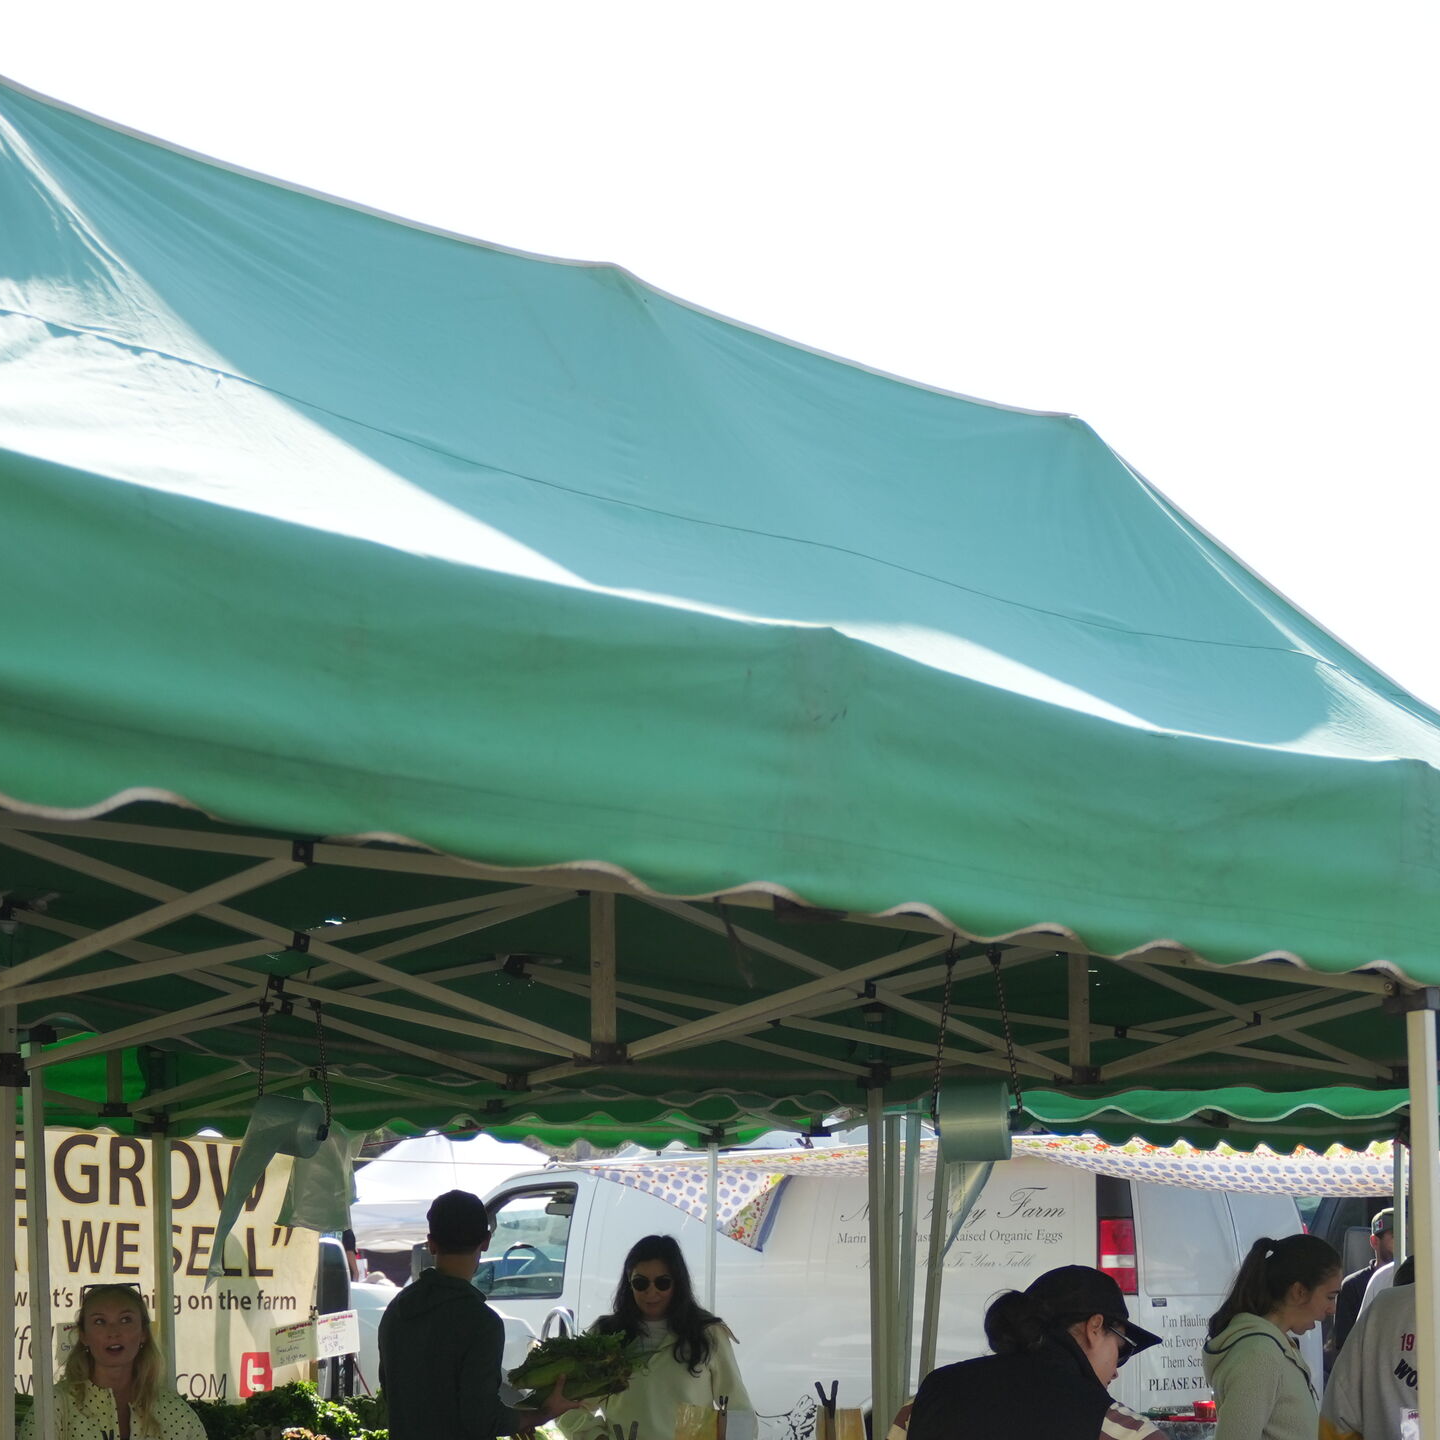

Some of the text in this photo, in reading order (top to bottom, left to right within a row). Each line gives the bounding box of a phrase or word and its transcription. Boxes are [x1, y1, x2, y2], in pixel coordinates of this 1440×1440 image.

[997, 1186, 1066, 1219] Farm
[989, 1229, 1033, 1246] Organic
[1035, 1229, 1064, 1244] Eggs
[62, 1219, 140, 1275] WE
[188, 1295, 213, 1310] on
[218, 1290, 252, 1311] the
[257, 1289, 297, 1311] farm
[1162, 1314, 1178, 1328] I'm
[1175, 1335, 1206, 1351] Everyo
[1400, 1333, 1415, 1352] 19
[1161, 1355, 1203, 1369] Them Scra
[1148, 1376, 1211, 1392] PLEASE STA
